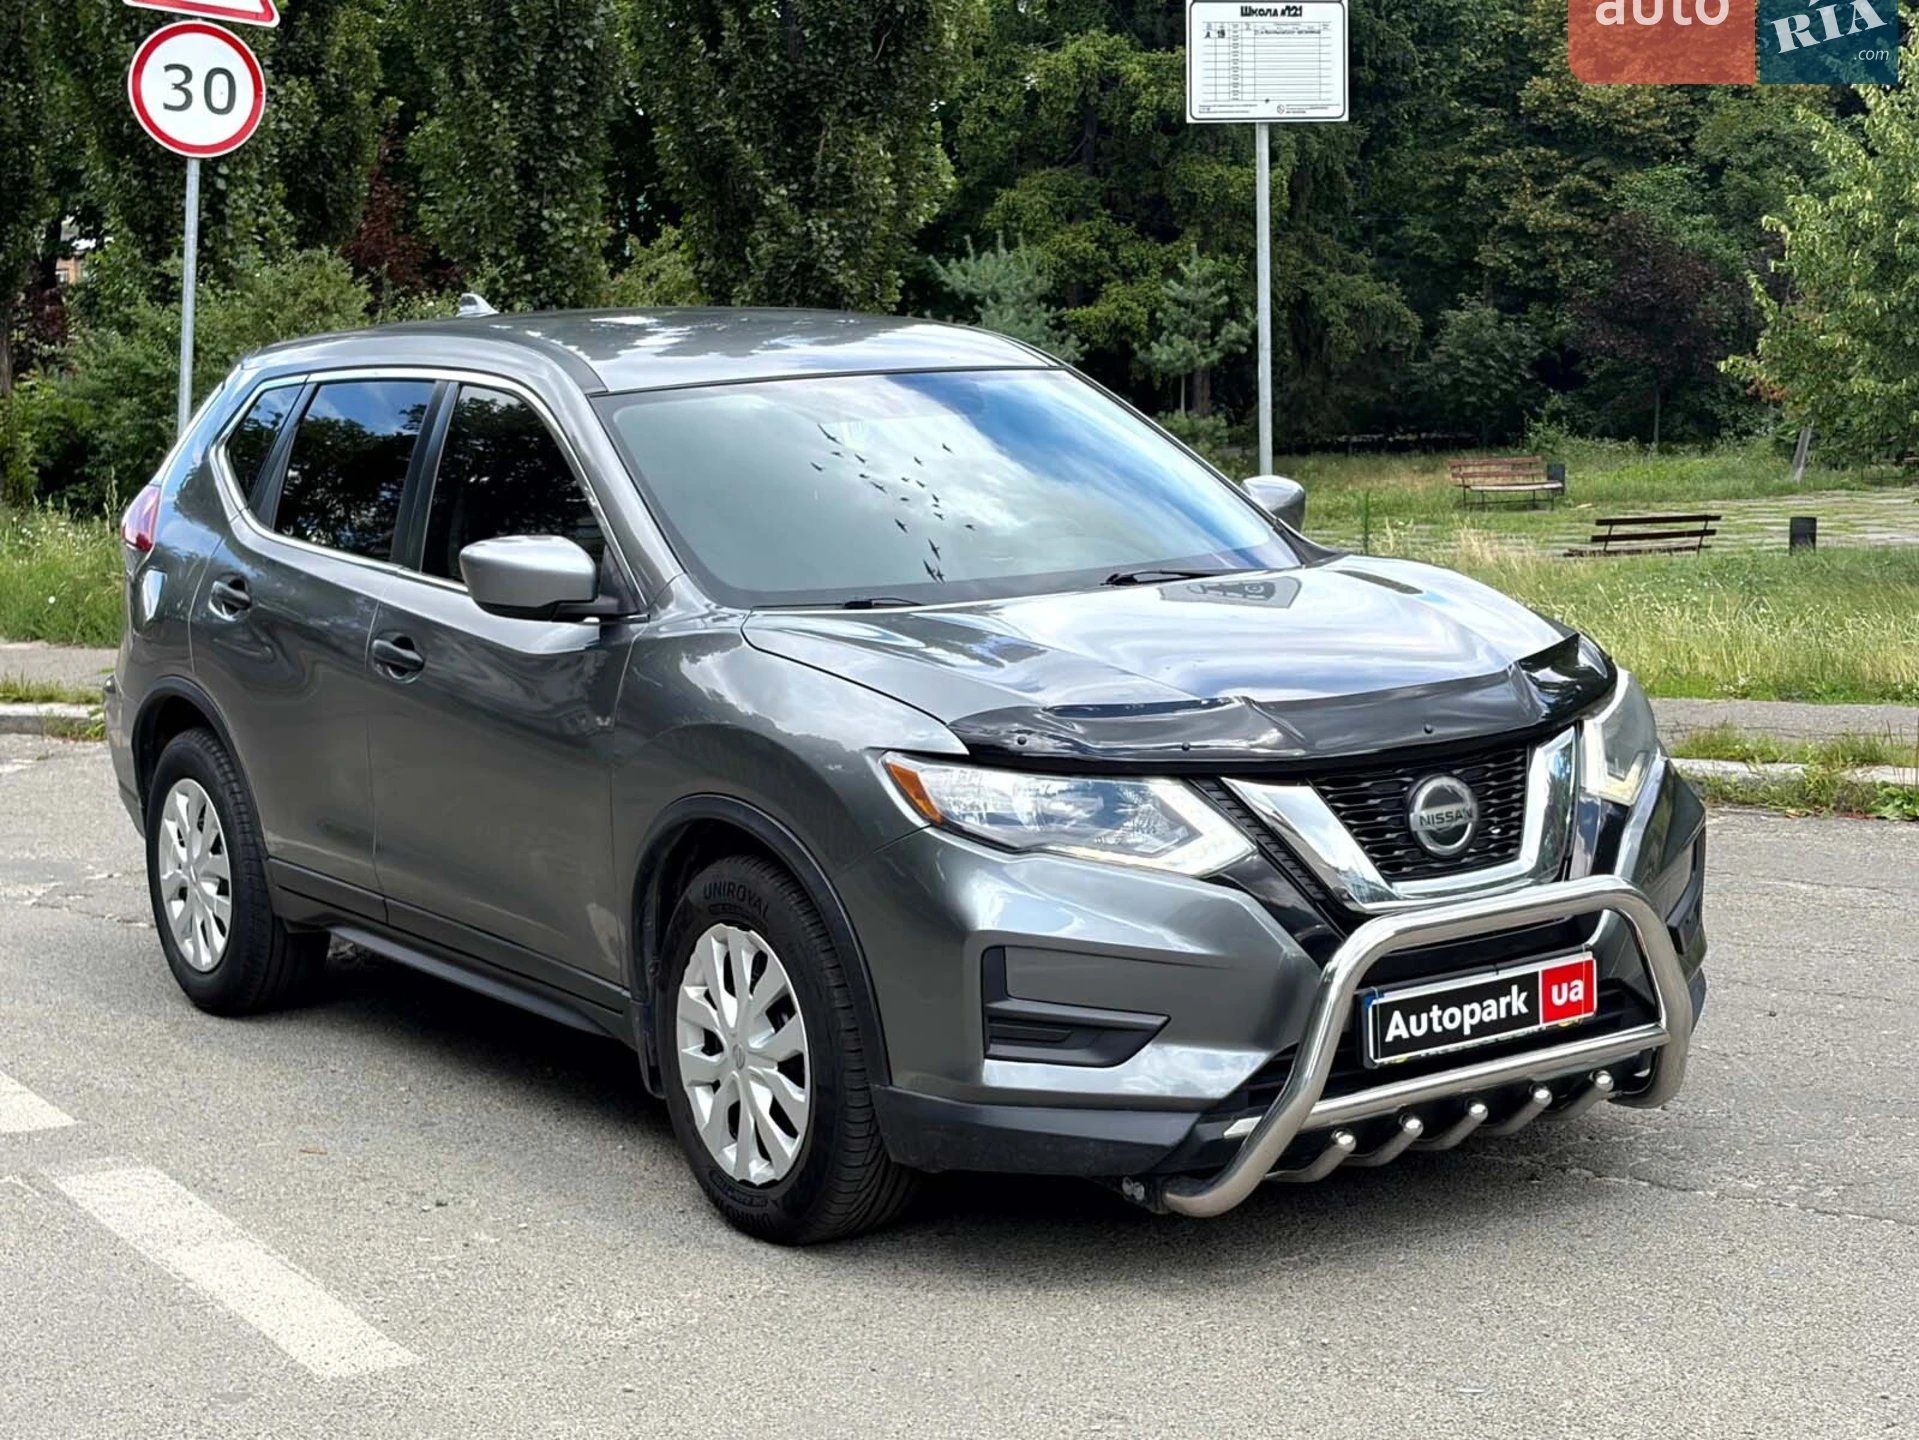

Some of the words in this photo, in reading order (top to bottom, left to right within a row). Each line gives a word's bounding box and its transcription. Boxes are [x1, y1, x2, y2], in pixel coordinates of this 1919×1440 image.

[163, 63, 236, 115] 30
[1420, 808, 1473, 826] NISSAN
[1385, 985, 1529, 1042] Autopark
[1551, 978, 1584, 1006] ua
